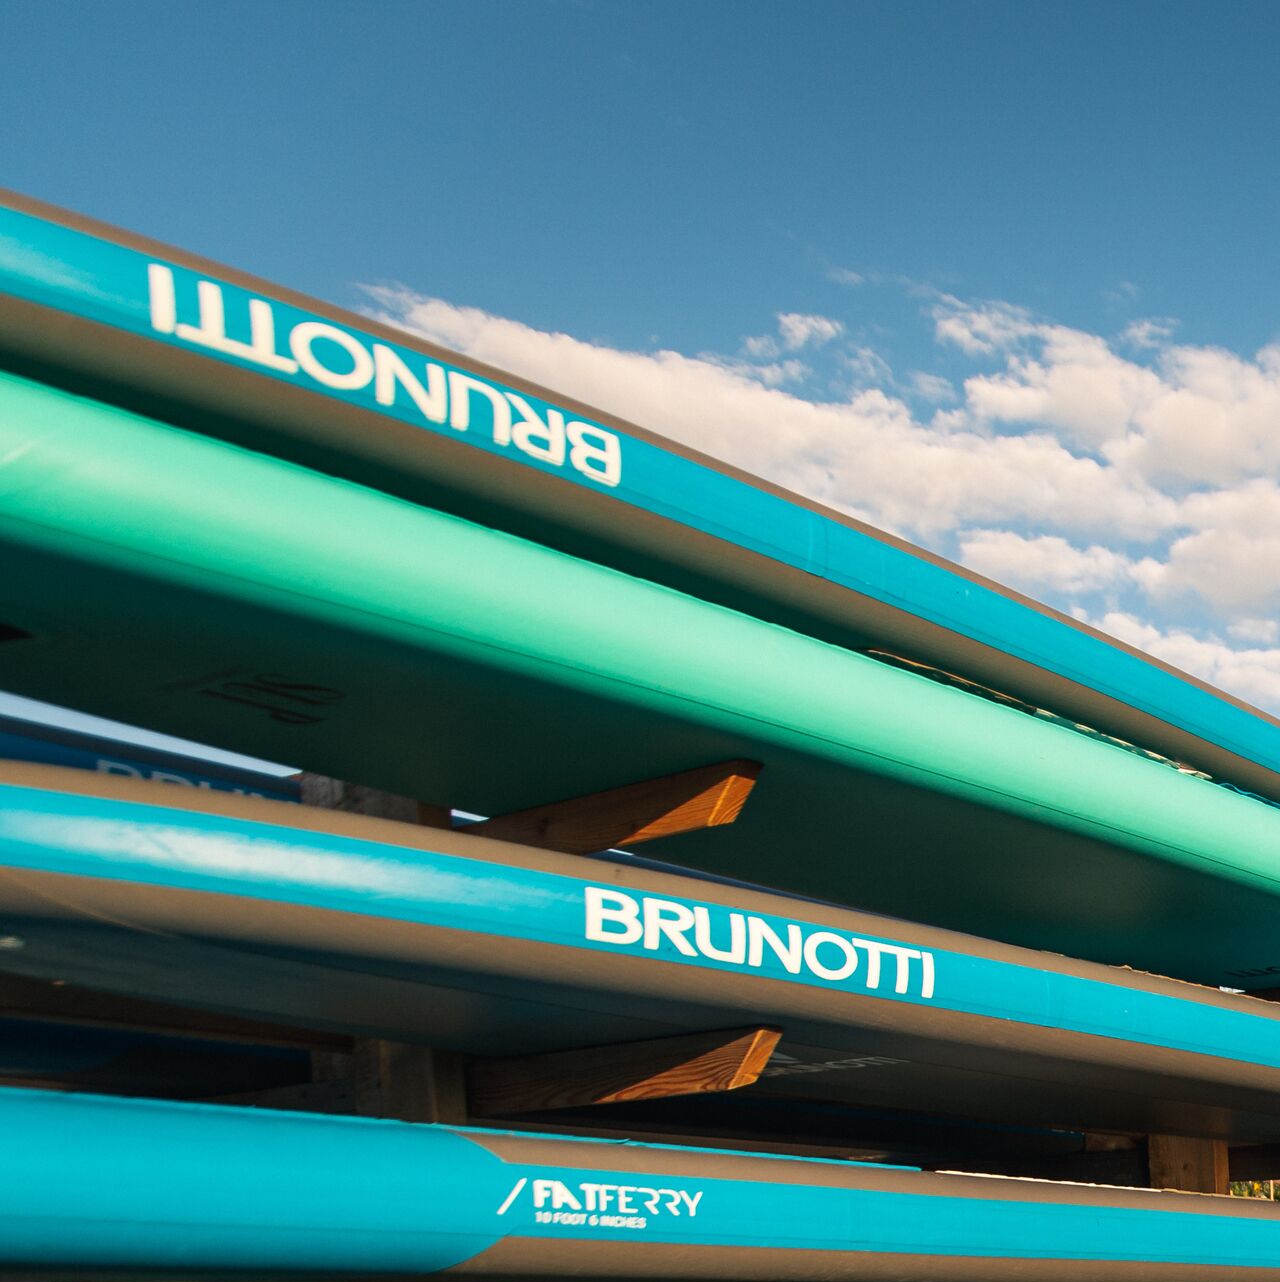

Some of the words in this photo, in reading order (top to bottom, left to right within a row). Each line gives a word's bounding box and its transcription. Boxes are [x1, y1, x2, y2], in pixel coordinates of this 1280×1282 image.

[148, 263, 622, 487] BRUNOTTI
[585, 886, 934, 999] BRUNOTTI
[535, 1211, 552, 1223] 10
[552, 1212, 588, 1225] FOOT
[588, 1214, 599, 1226] 6
[599, 1215, 647, 1229] INCHES
